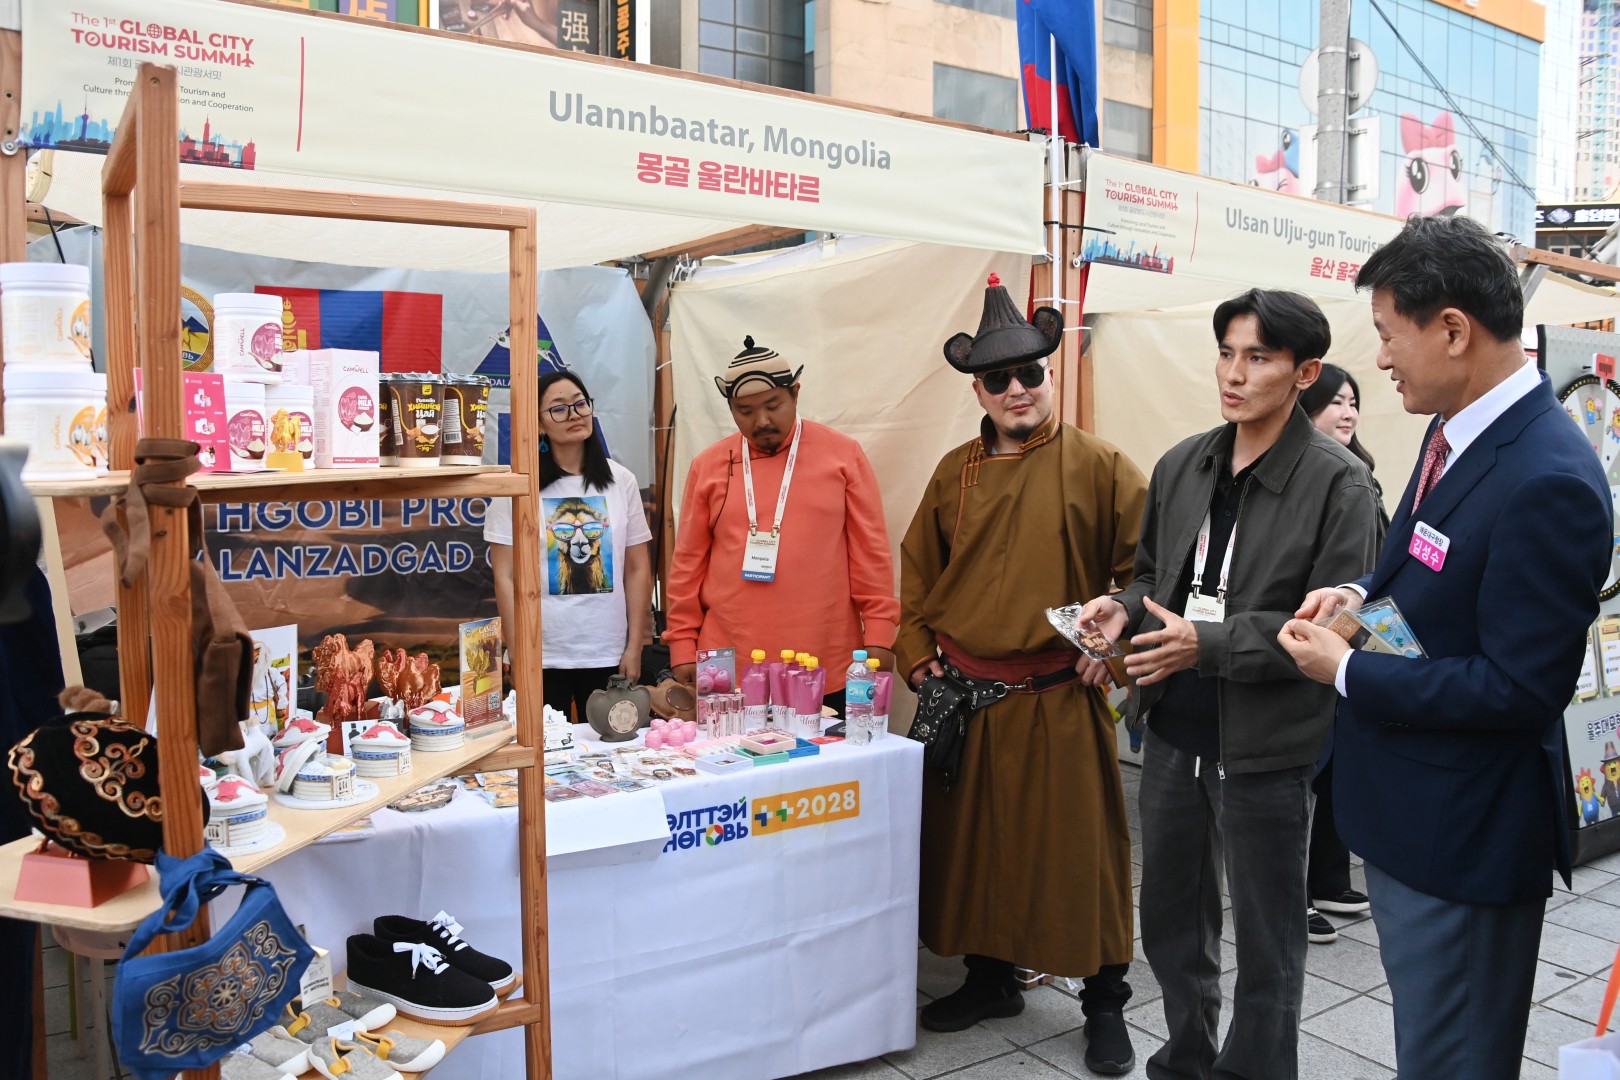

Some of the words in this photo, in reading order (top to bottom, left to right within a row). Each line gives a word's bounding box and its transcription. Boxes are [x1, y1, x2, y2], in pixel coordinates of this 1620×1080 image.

[70, 28, 168, 56] TOURISM
[71, 12, 99, 27] The
[103, 17, 116, 28] 1st
[119, 19, 204, 45] GLOBAL
[208, 33, 254, 51] CITY
[561, 10, 590, 52] 强
[108, 56, 132, 68] 제1회
[83, 84, 113, 95] Culture
[191, 99, 206, 107] and
[208, 100, 254, 112] Cooperation
[180, 86, 209, 97] Tourism
[211, 91, 226, 99] and
[549, 90, 755, 154] Ulannbaatar,
[763, 125, 891, 170] Mongolia
[636, 152, 691, 188] 몽골
[697, 160, 820, 203] 울란바타르
[1125, 183, 1158, 198] GLOBAL
[1160, 190, 1178, 201] CITY
[1105, 189, 1145, 205] TOURISM
[1226, 207, 1269, 235] Ulsan
[1273, 216, 1335, 249] Ulju-gun
[1310, 256, 1335, 279] 울산
[1336, 261, 1361, 283] 울주
[216, 500, 383, 532] HGOBI
[402, 497, 494, 526] PRO
[197, 541, 474, 582] LANZADGAD
[1412, 538, 1440, 566] 김성수
[666, 796, 747, 831] ЭЛТТЭЙ
[796, 789, 856, 819] 2028
[662, 822, 749, 853] НӨГОВЬ
